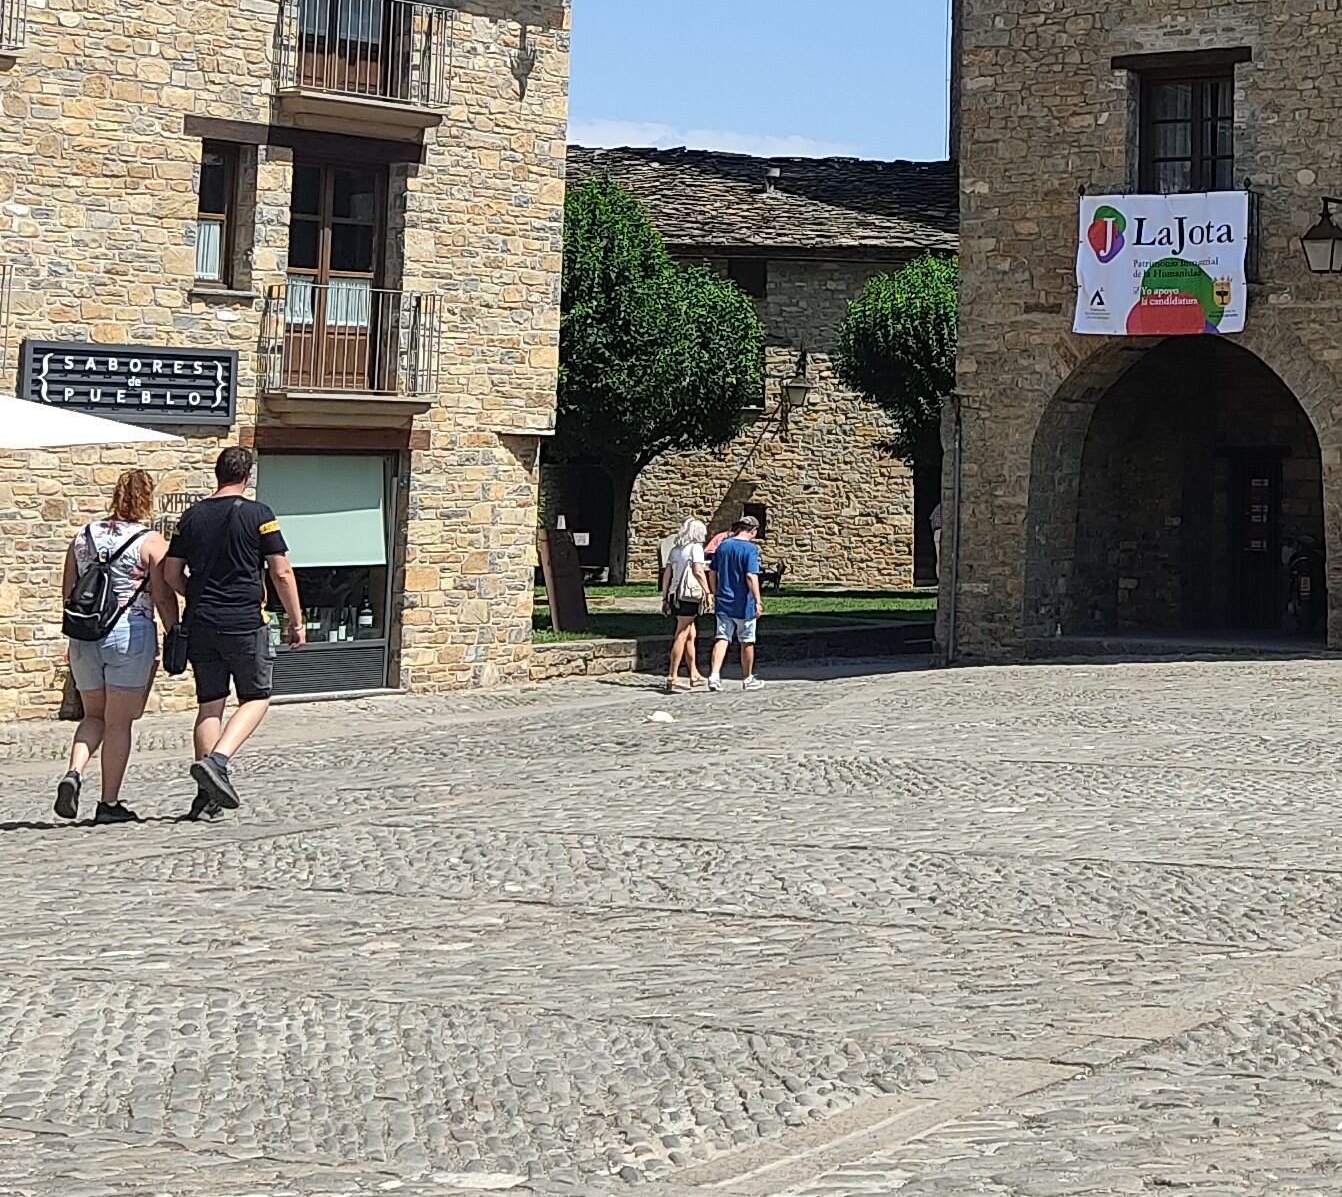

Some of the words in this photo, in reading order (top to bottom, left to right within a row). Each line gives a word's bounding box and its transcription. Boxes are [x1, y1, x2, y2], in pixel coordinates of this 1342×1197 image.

[1132, 217, 1234, 255] LaJota
[1141, 286, 1152, 295] Yo
[1153, 288, 1179, 297] apoyo
[1149, 297, 1198, 306] candidatura
[63, 355, 204, 375] SABORES
[127, 376, 142, 387] de
[63, 387, 202, 406] PUEBLO
